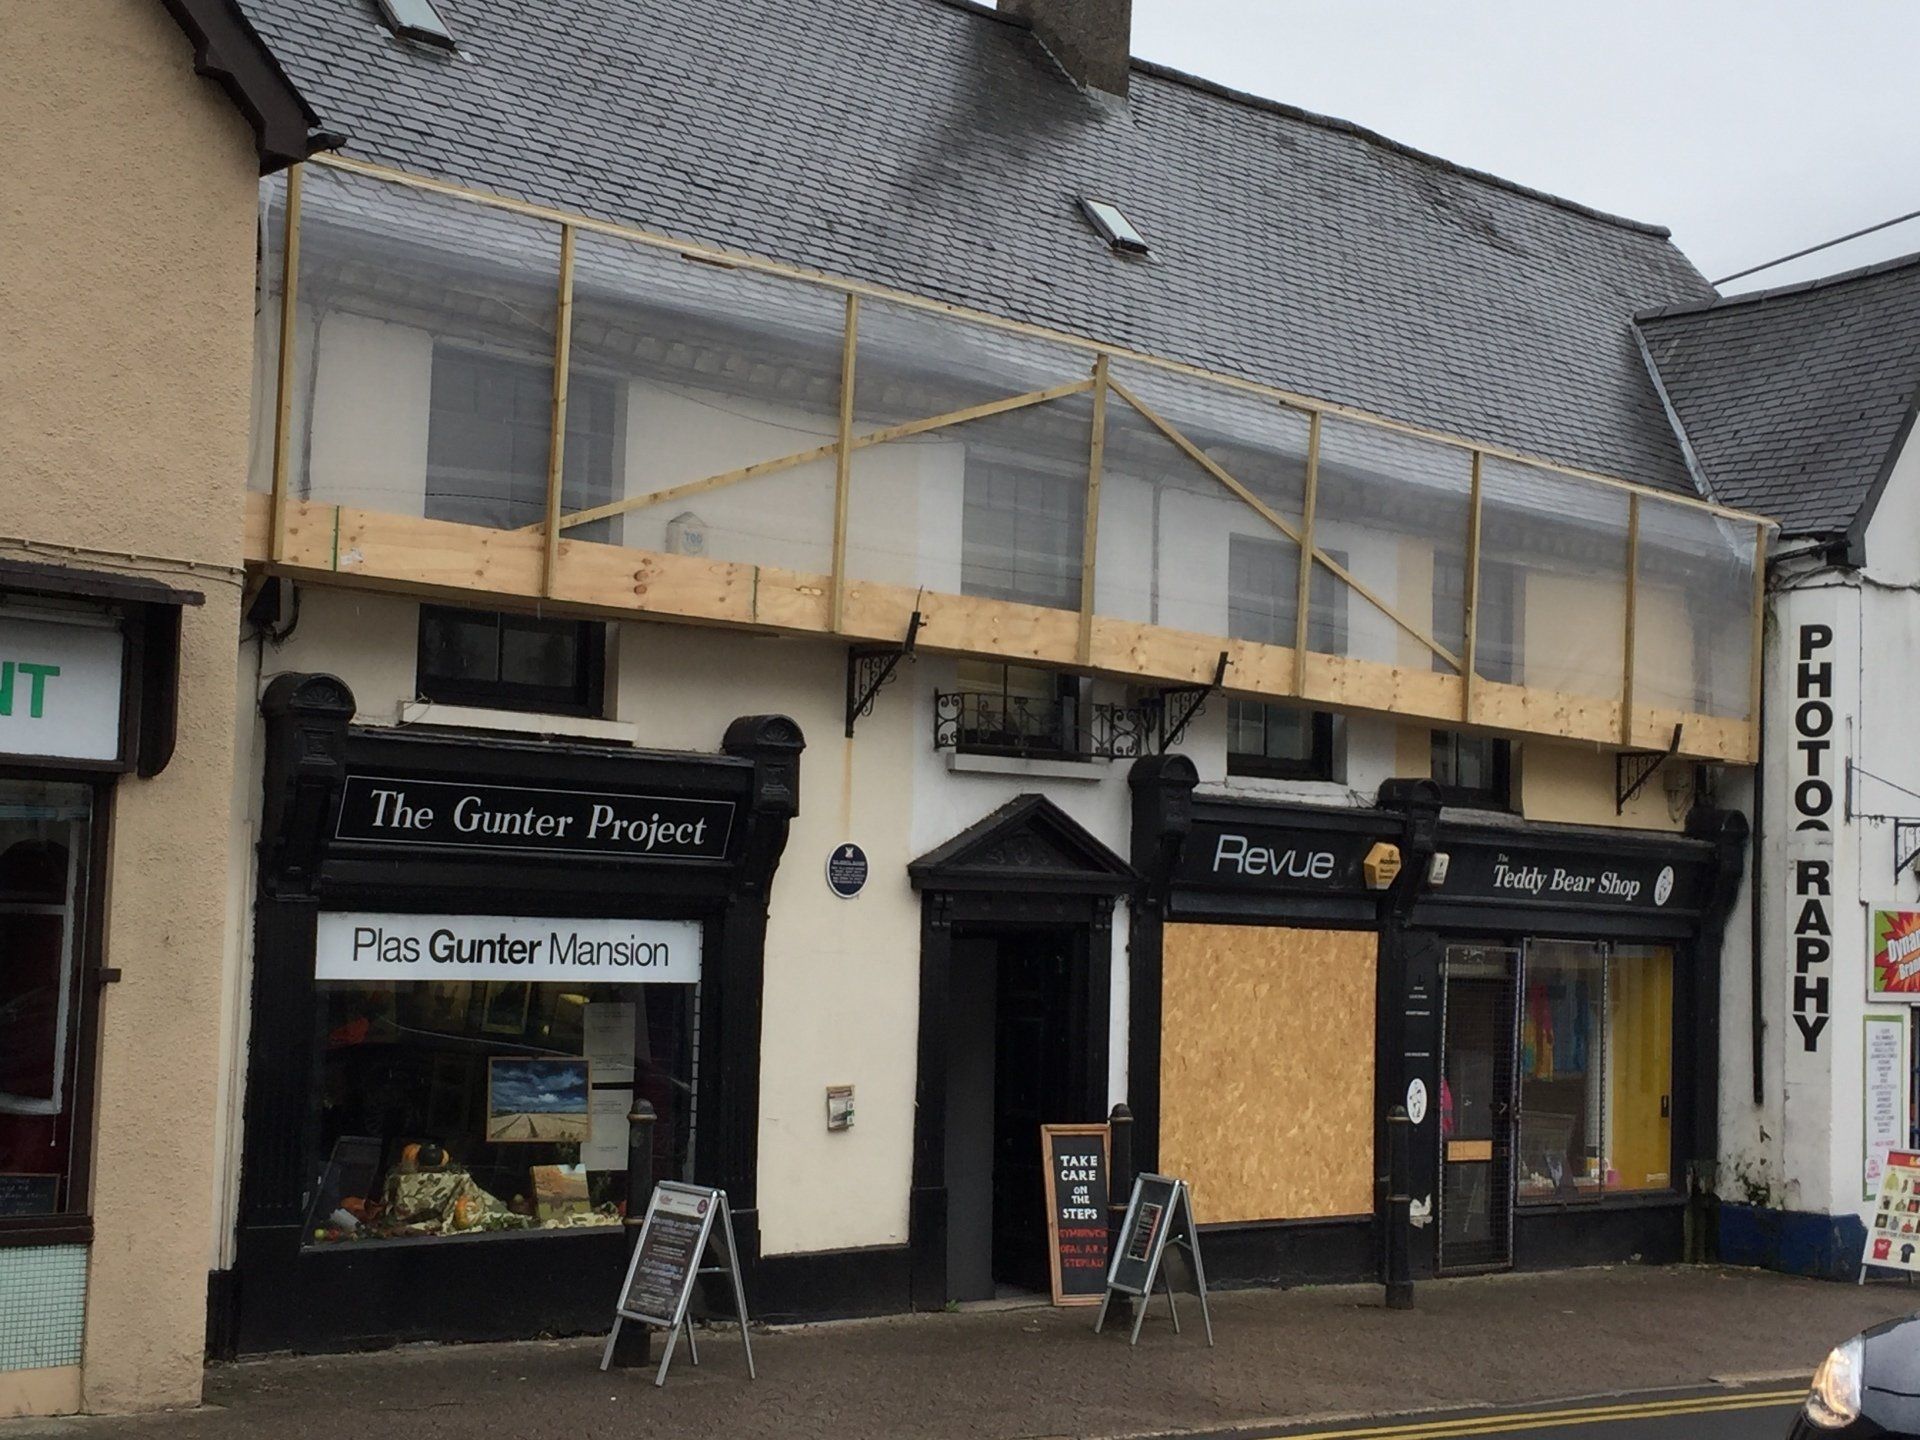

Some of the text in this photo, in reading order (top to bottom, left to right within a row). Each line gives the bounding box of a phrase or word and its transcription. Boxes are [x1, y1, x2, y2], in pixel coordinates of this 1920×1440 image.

[371, 789, 707, 851] The Gunter Project
[1792, 624, 1834, 1053] PHOTORAPHY
[1213, 834, 1335, 879] Revue
[1493, 864, 1641, 901] Teddy Bear Shop
[353, 927, 669, 967] Plas Gunter Mansion
[1887, 929, 1920, 964] Dyna
[1060, 1155, 1098, 1167] TAKE
[1061, 1170, 1096, 1181] CARE
[1071, 1195, 1090, 1205] THE
[1073, 1185, 1088, 1195] ON
[1062, 1208, 1098, 1220] STEPS
